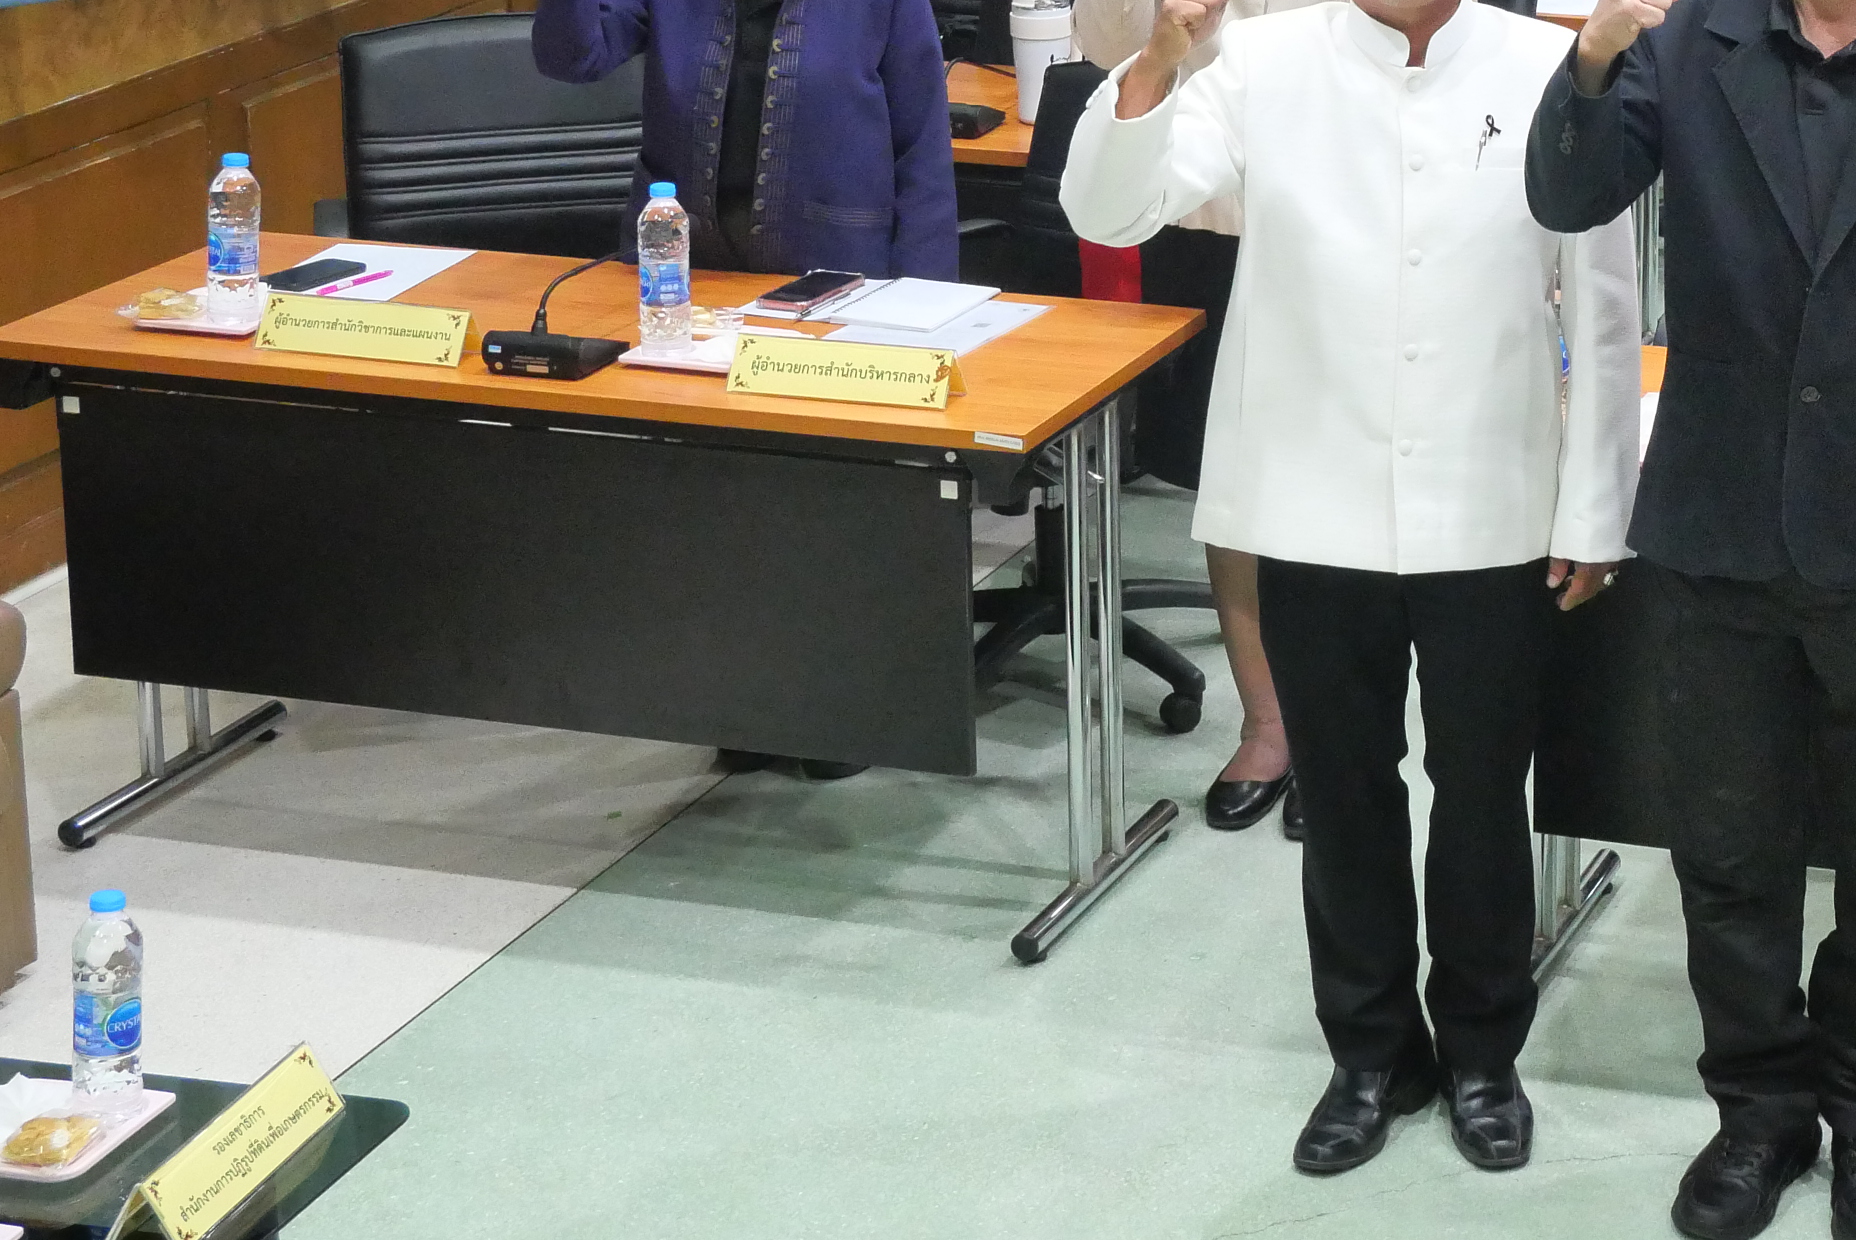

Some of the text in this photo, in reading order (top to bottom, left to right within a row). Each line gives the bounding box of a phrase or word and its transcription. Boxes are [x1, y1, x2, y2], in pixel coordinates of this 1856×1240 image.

[274, 312, 451, 341] ผู้อำนวยการสำนักวิชาการและแผนงาน
[751, 354, 931, 384] ผู้อำนวยการสำนักบริหารกลาง
[212, 1105, 266, 1155] รองเลขาธิการ
